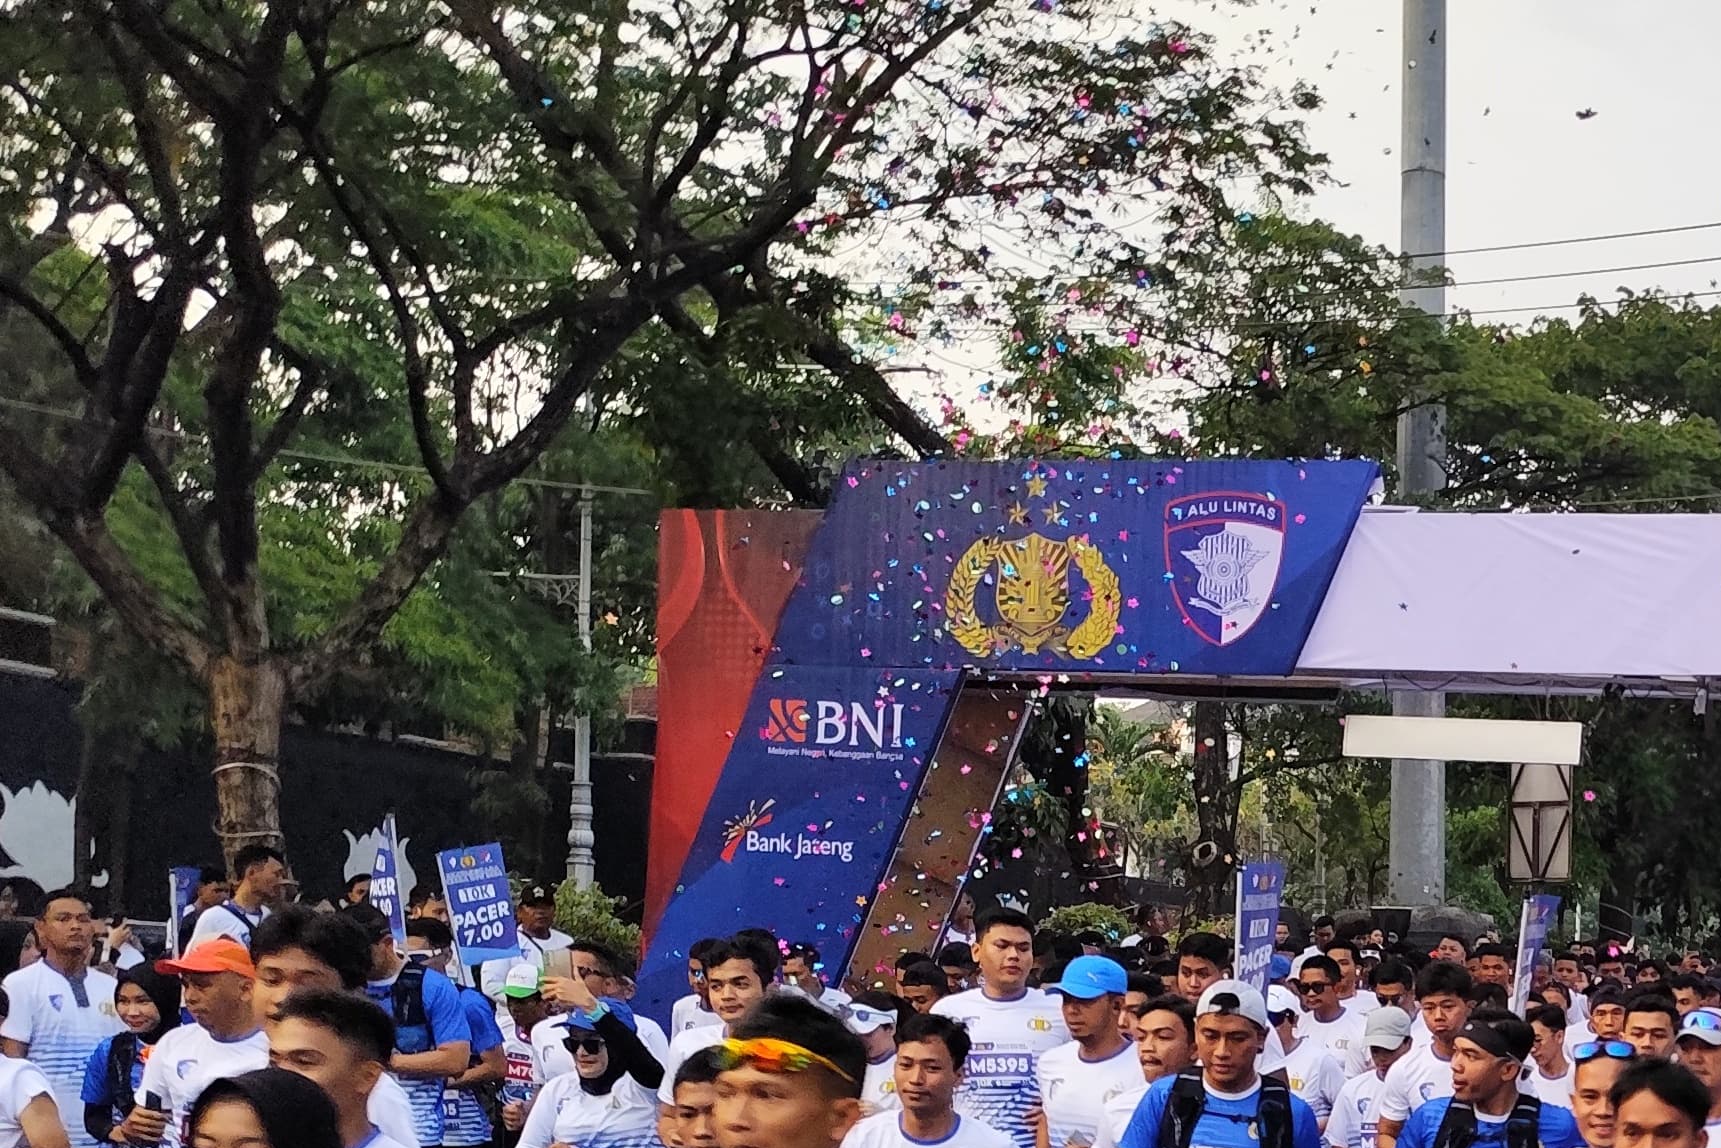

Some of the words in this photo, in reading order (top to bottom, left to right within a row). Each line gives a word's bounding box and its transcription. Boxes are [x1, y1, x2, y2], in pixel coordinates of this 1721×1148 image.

[1224, 501, 1276, 521] LINTAS
[815, 700, 905, 749] BNI
[746, 830, 793, 854] Bank
[793, 832, 854, 863] Jateng
[463, 885, 491, 902] 10K
[453, 900, 511, 932] PACER
[463, 921, 504, 946] 7.00
[1239, 943, 1273, 975] PACER
[970, 1056, 1029, 1074] M5395
